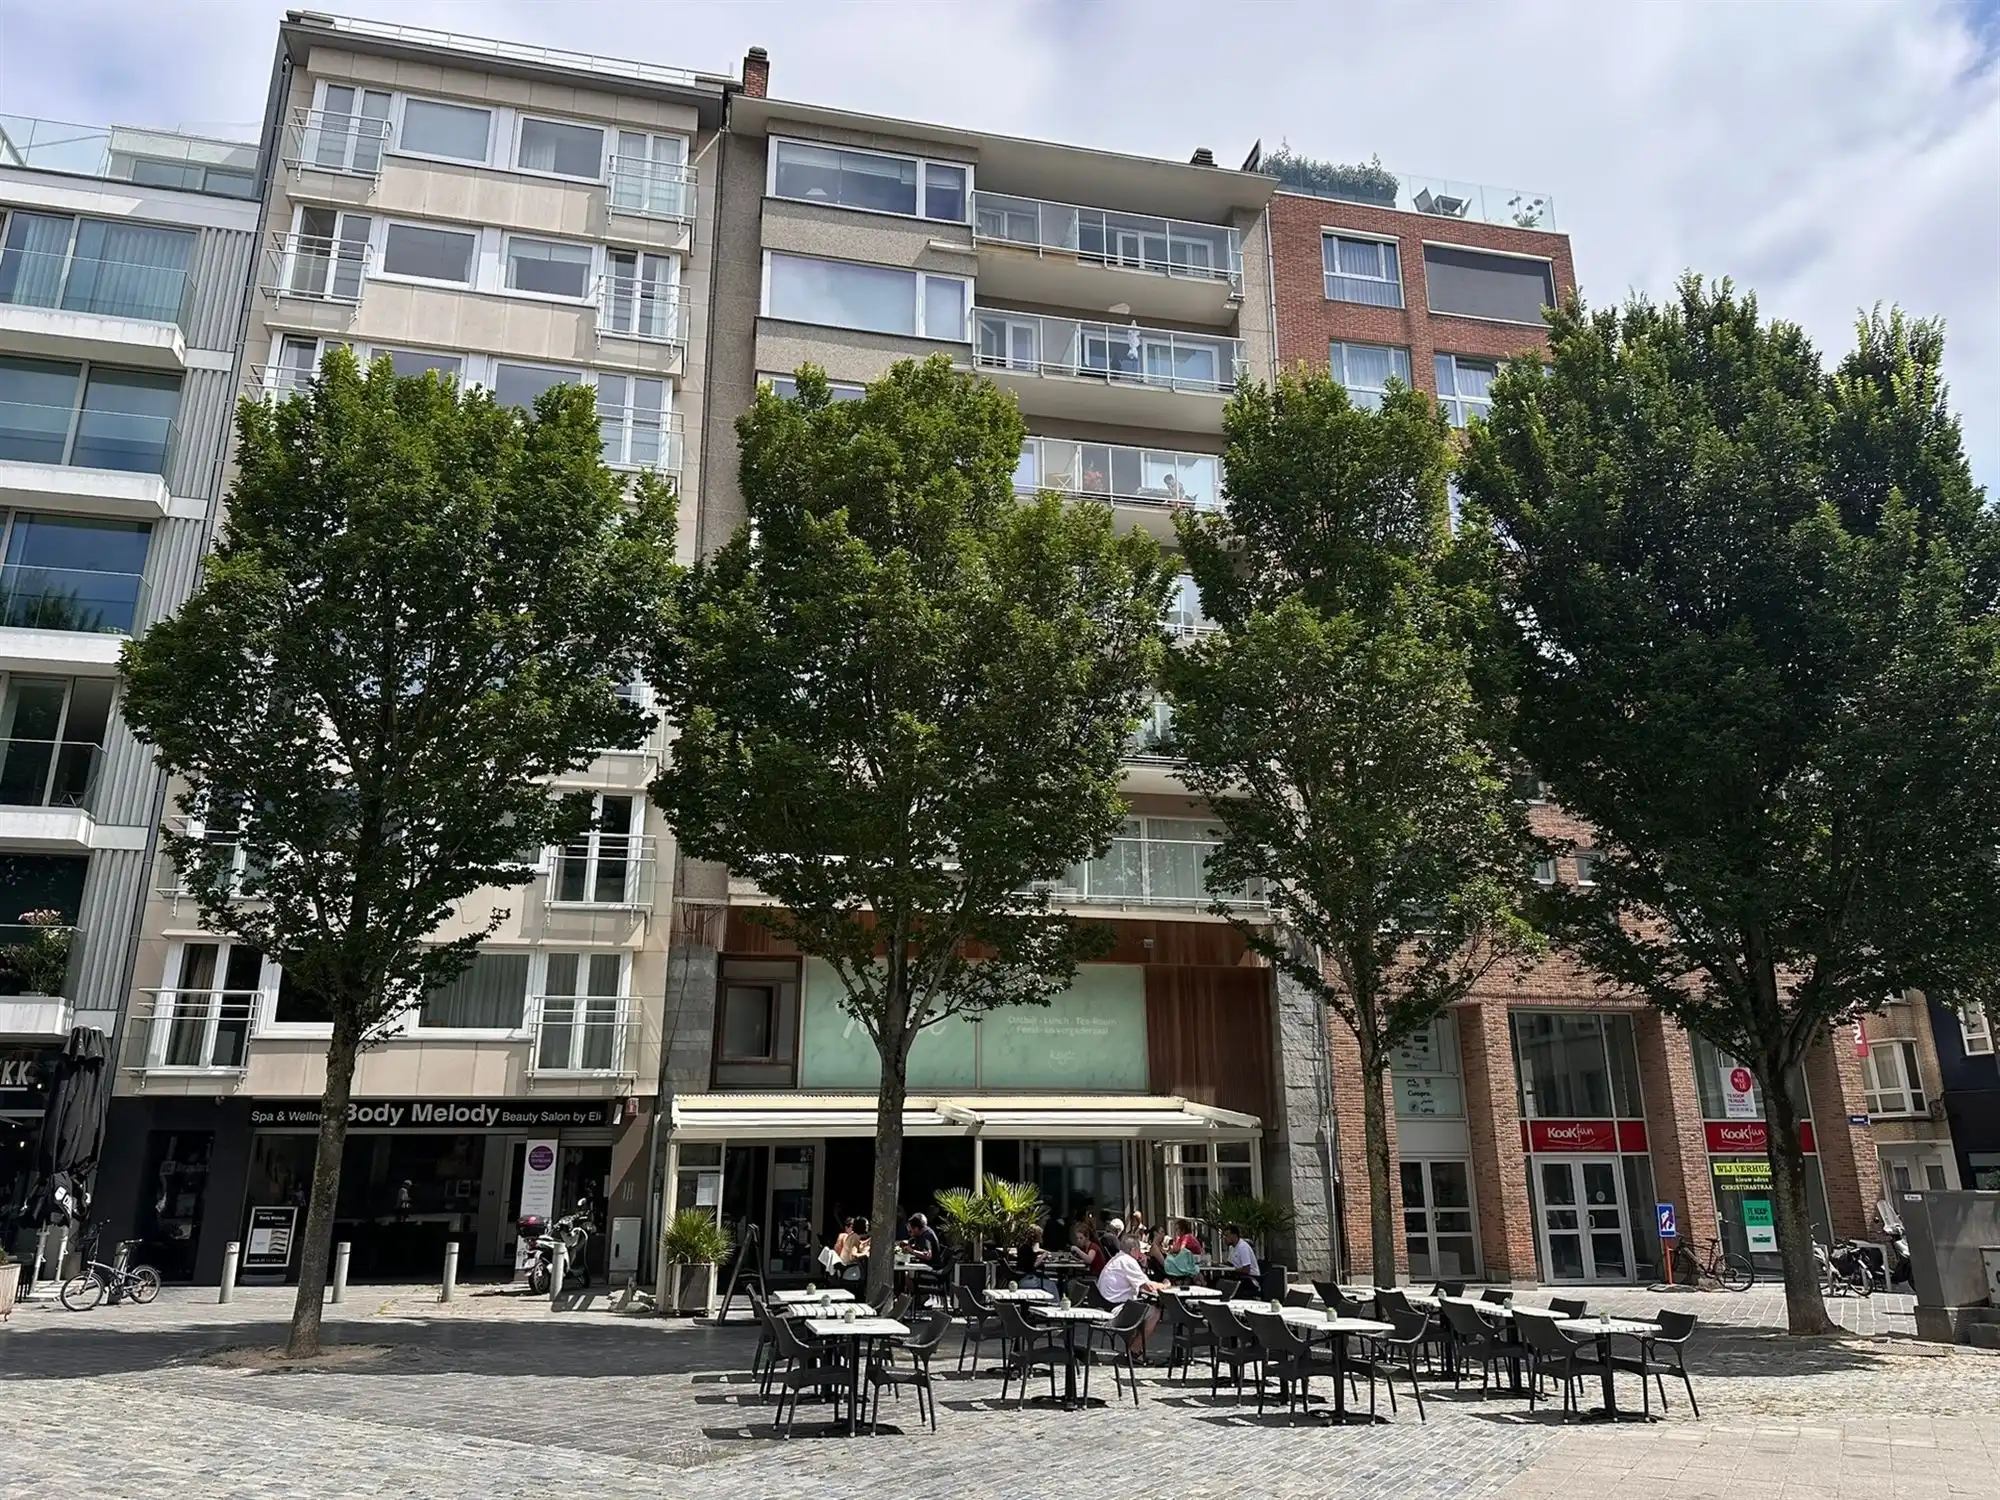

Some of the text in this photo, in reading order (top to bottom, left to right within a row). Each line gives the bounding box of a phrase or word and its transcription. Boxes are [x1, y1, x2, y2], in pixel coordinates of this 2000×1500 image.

[0, 1060, 32, 1086] KK
[251, 1110, 274, 1124] Spa
[276, 1111, 286, 1122] &
[289, 1111, 323, 1122] Wellne
[347, 1103, 404, 1126] Body
[411, 1104, 500, 1126] Melody
[502, 1111, 539, 1124] Beauty
[541, 1111, 570, 1121] Salon
[573, 1111, 586, 1123] by
[1716, 1165, 1732, 1173] WIJ
